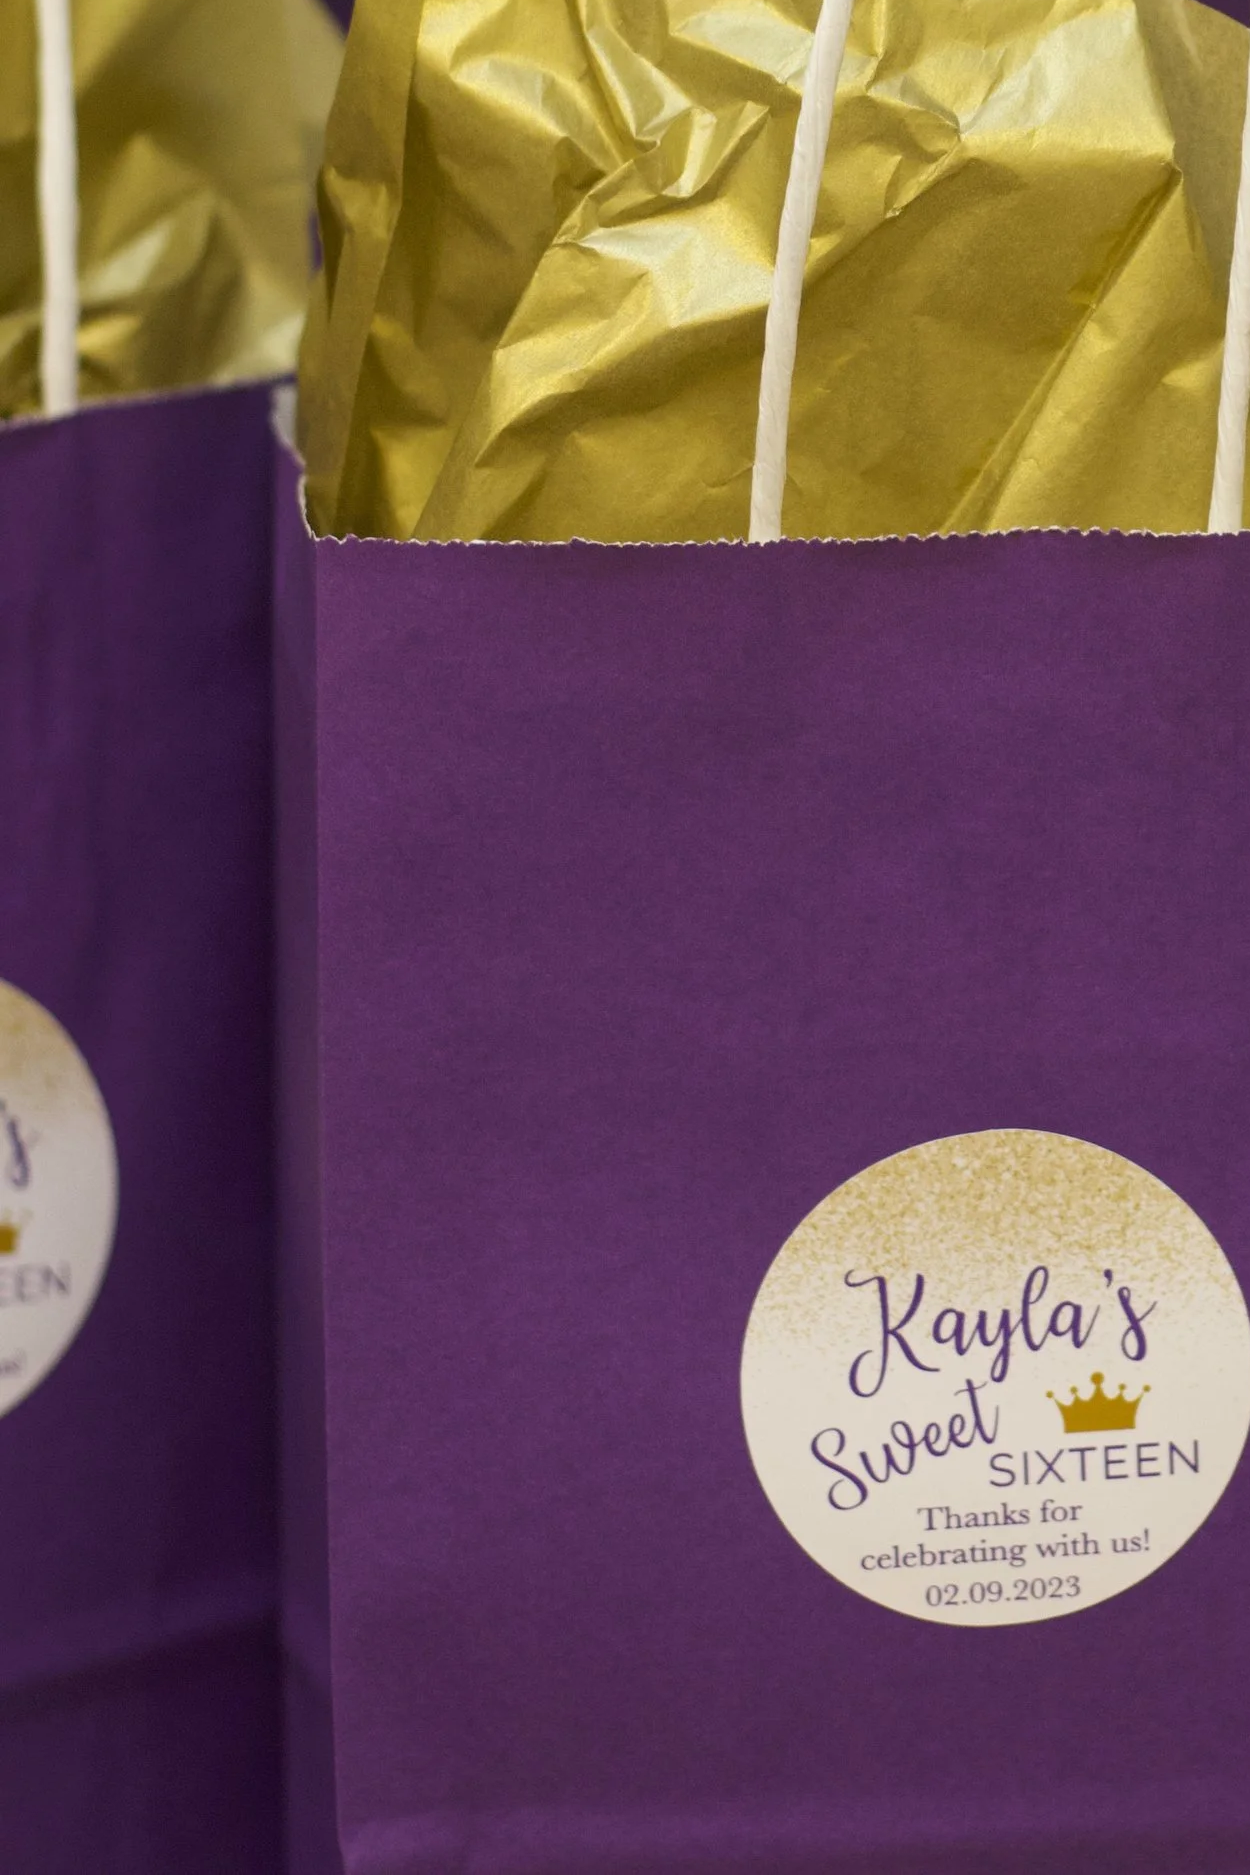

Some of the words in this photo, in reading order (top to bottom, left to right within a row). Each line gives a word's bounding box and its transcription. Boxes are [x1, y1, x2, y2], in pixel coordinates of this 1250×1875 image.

[843, 1265, 1158, 1399] Kayla's
[810, 1378, 1000, 1512] Sweet
[988, 1440, 1201, 1488] SIXTEEN
[917, 1502, 1031, 1531] Thanks
[1040, 1499, 1083, 1524] for
[860, 1537, 1027, 1571] celebrating
[1036, 1532, 1101, 1558] with
[1111, 1528, 1151, 1554] us!
[925, 1575, 1082, 1607] 02.09.2023
